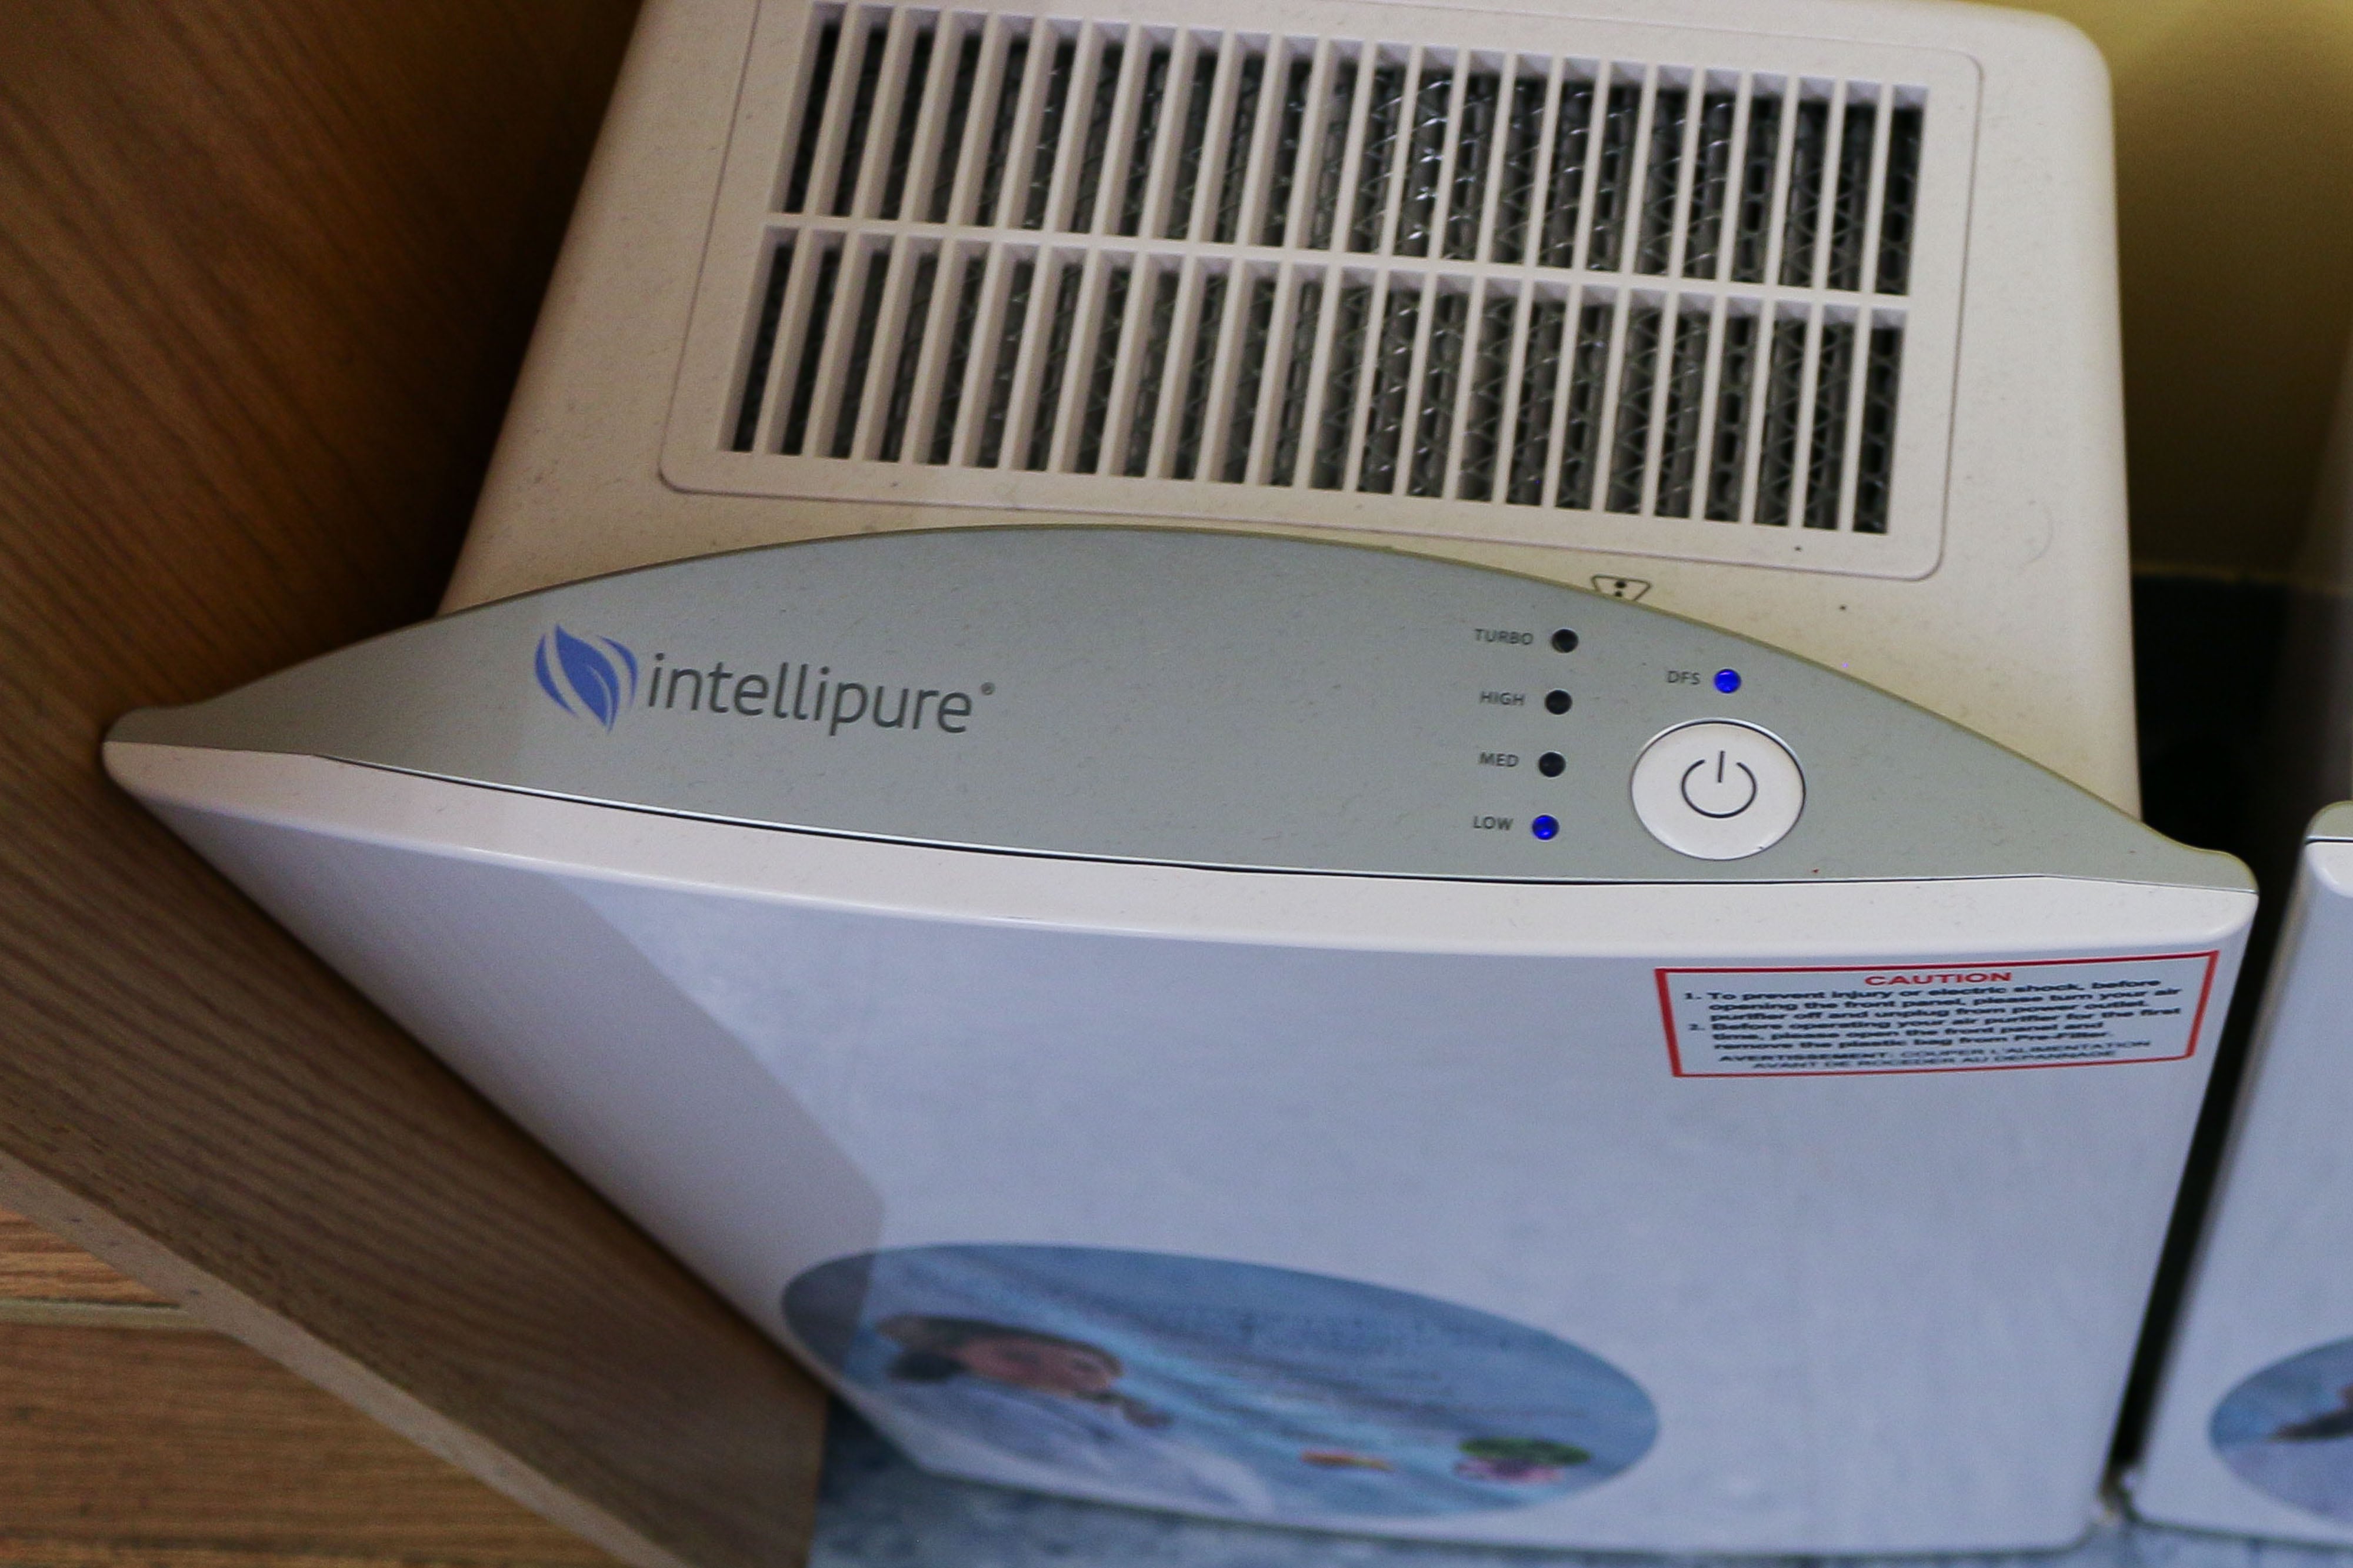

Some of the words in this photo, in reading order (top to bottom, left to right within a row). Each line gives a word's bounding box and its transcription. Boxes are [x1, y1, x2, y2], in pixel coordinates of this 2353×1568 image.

[1474, 628, 1534, 646] TURBO
[1666, 669, 1701, 685] DFS
[1479, 691, 1525, 707] HIGH
[1478, 751, 1519, 768] MED
[1472, 815, 1514, 831] LOW
[1864, 972, 2012, 986] CAUTION
[1742, 992, 1825, 1000] prevent
[1832, 990, 1893, 999] injury
[1928, 987, 2007, 995] electric
[2092, 980, 2161, 989] before
[1973, 996, 2042, 1006] please
[2099, 991, 2148, 1000] your
[1711, 1013, 1788, 1022] purifier
[1875, 1009, 1949, 1017] unplug
[2012, 1005, 2080, 1014] power
[1771, 1032, 1839, 1040] please
[2001, 1024, 2058, 1034] panel
[2065, 1020, 2104, 1029] and
[1789, 1022, 1891, 1030] operating
[1898, 1020, 1945, 1028] your
[1839, 1040, 1906, 1049] plastic
